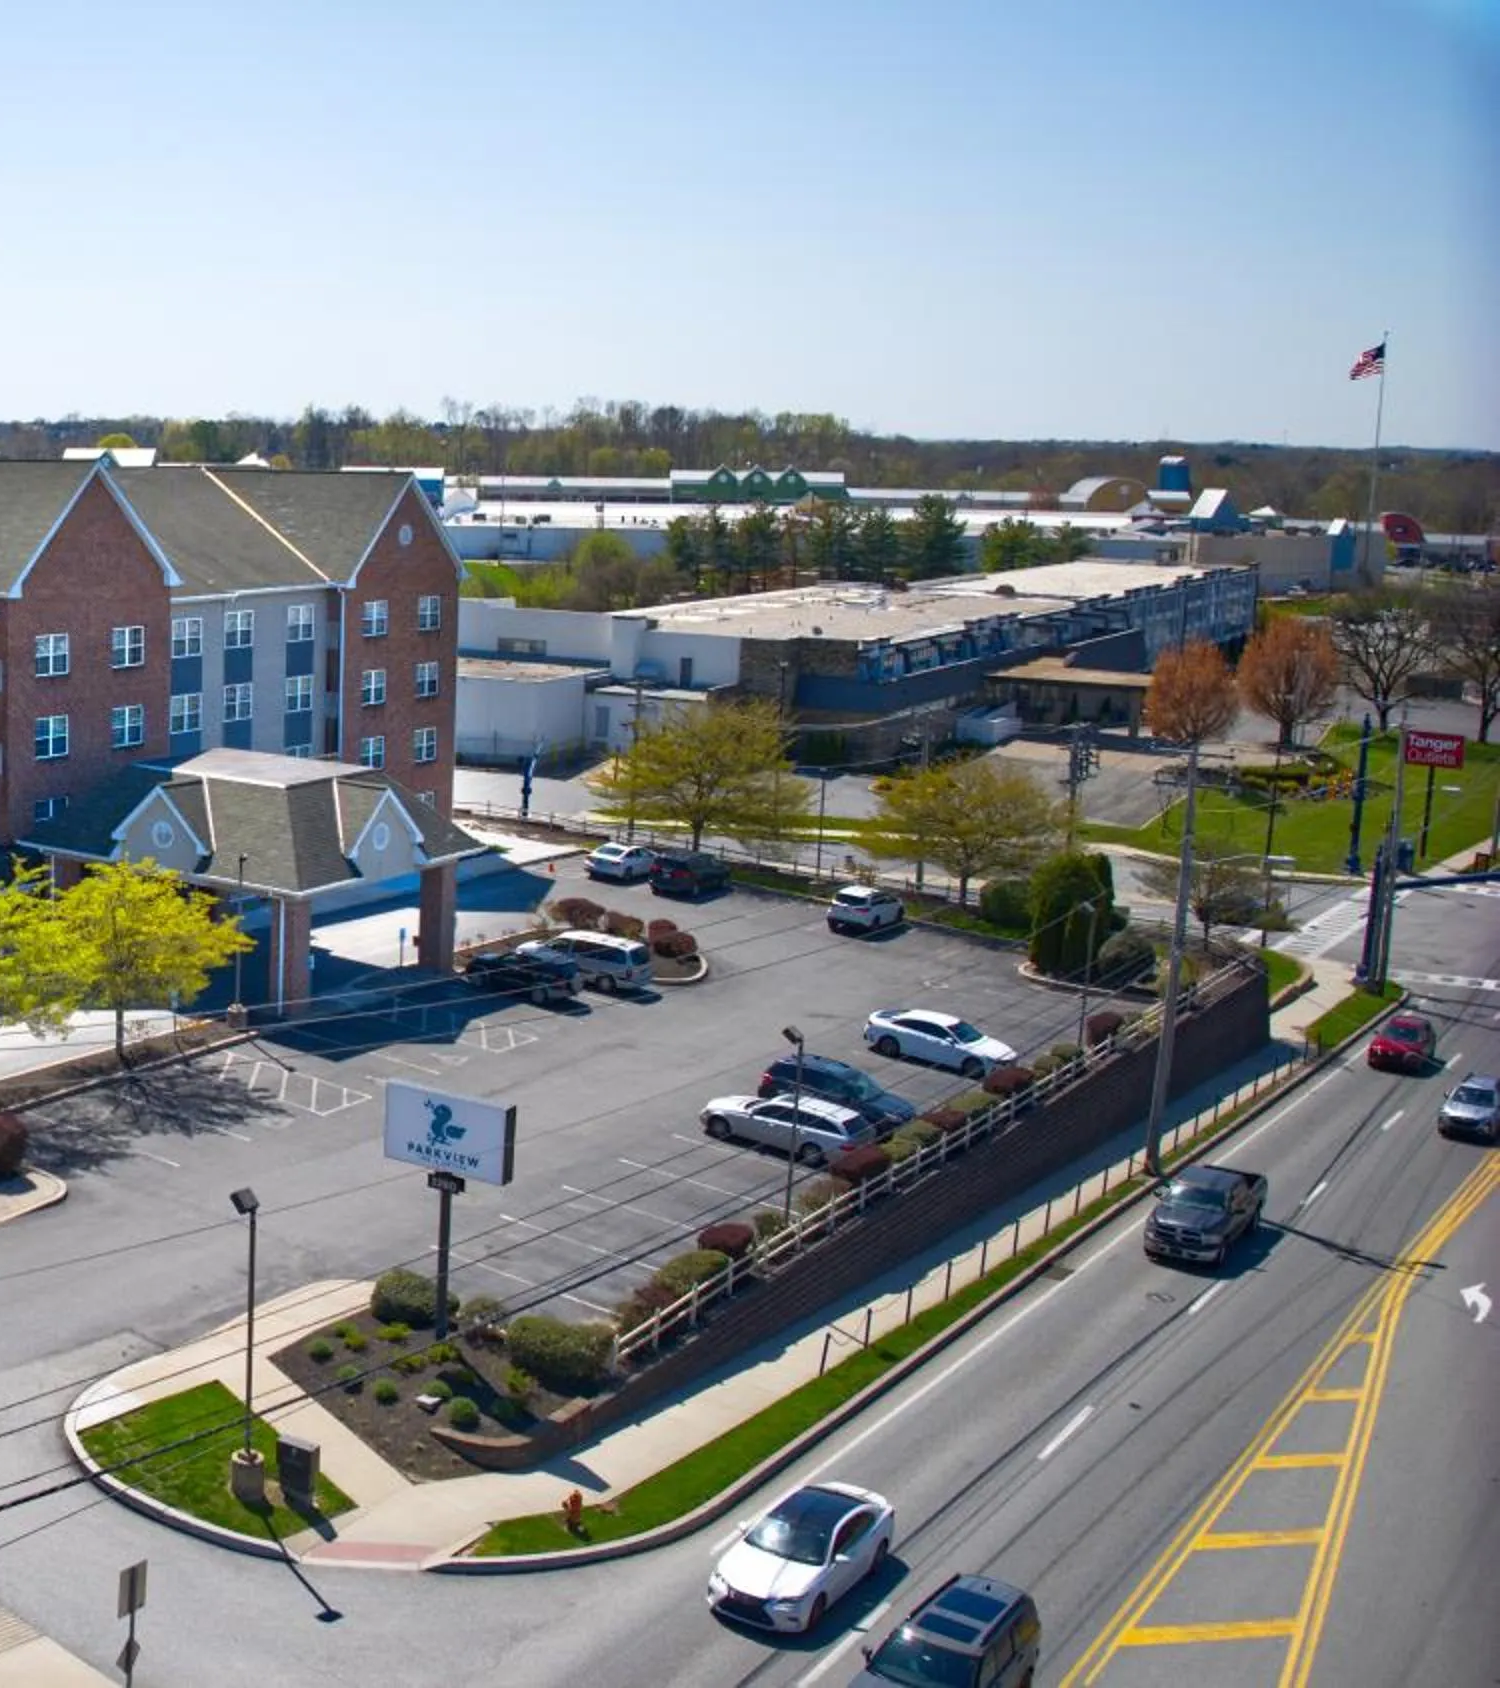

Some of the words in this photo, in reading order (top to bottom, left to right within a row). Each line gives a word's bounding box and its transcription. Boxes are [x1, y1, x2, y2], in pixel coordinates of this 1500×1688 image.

[1409, 734, 1460, 752] Tanger
[1407, 748, 1457, 765] Outlets
[407, 1141, 479, 1169] PARKVIEW
